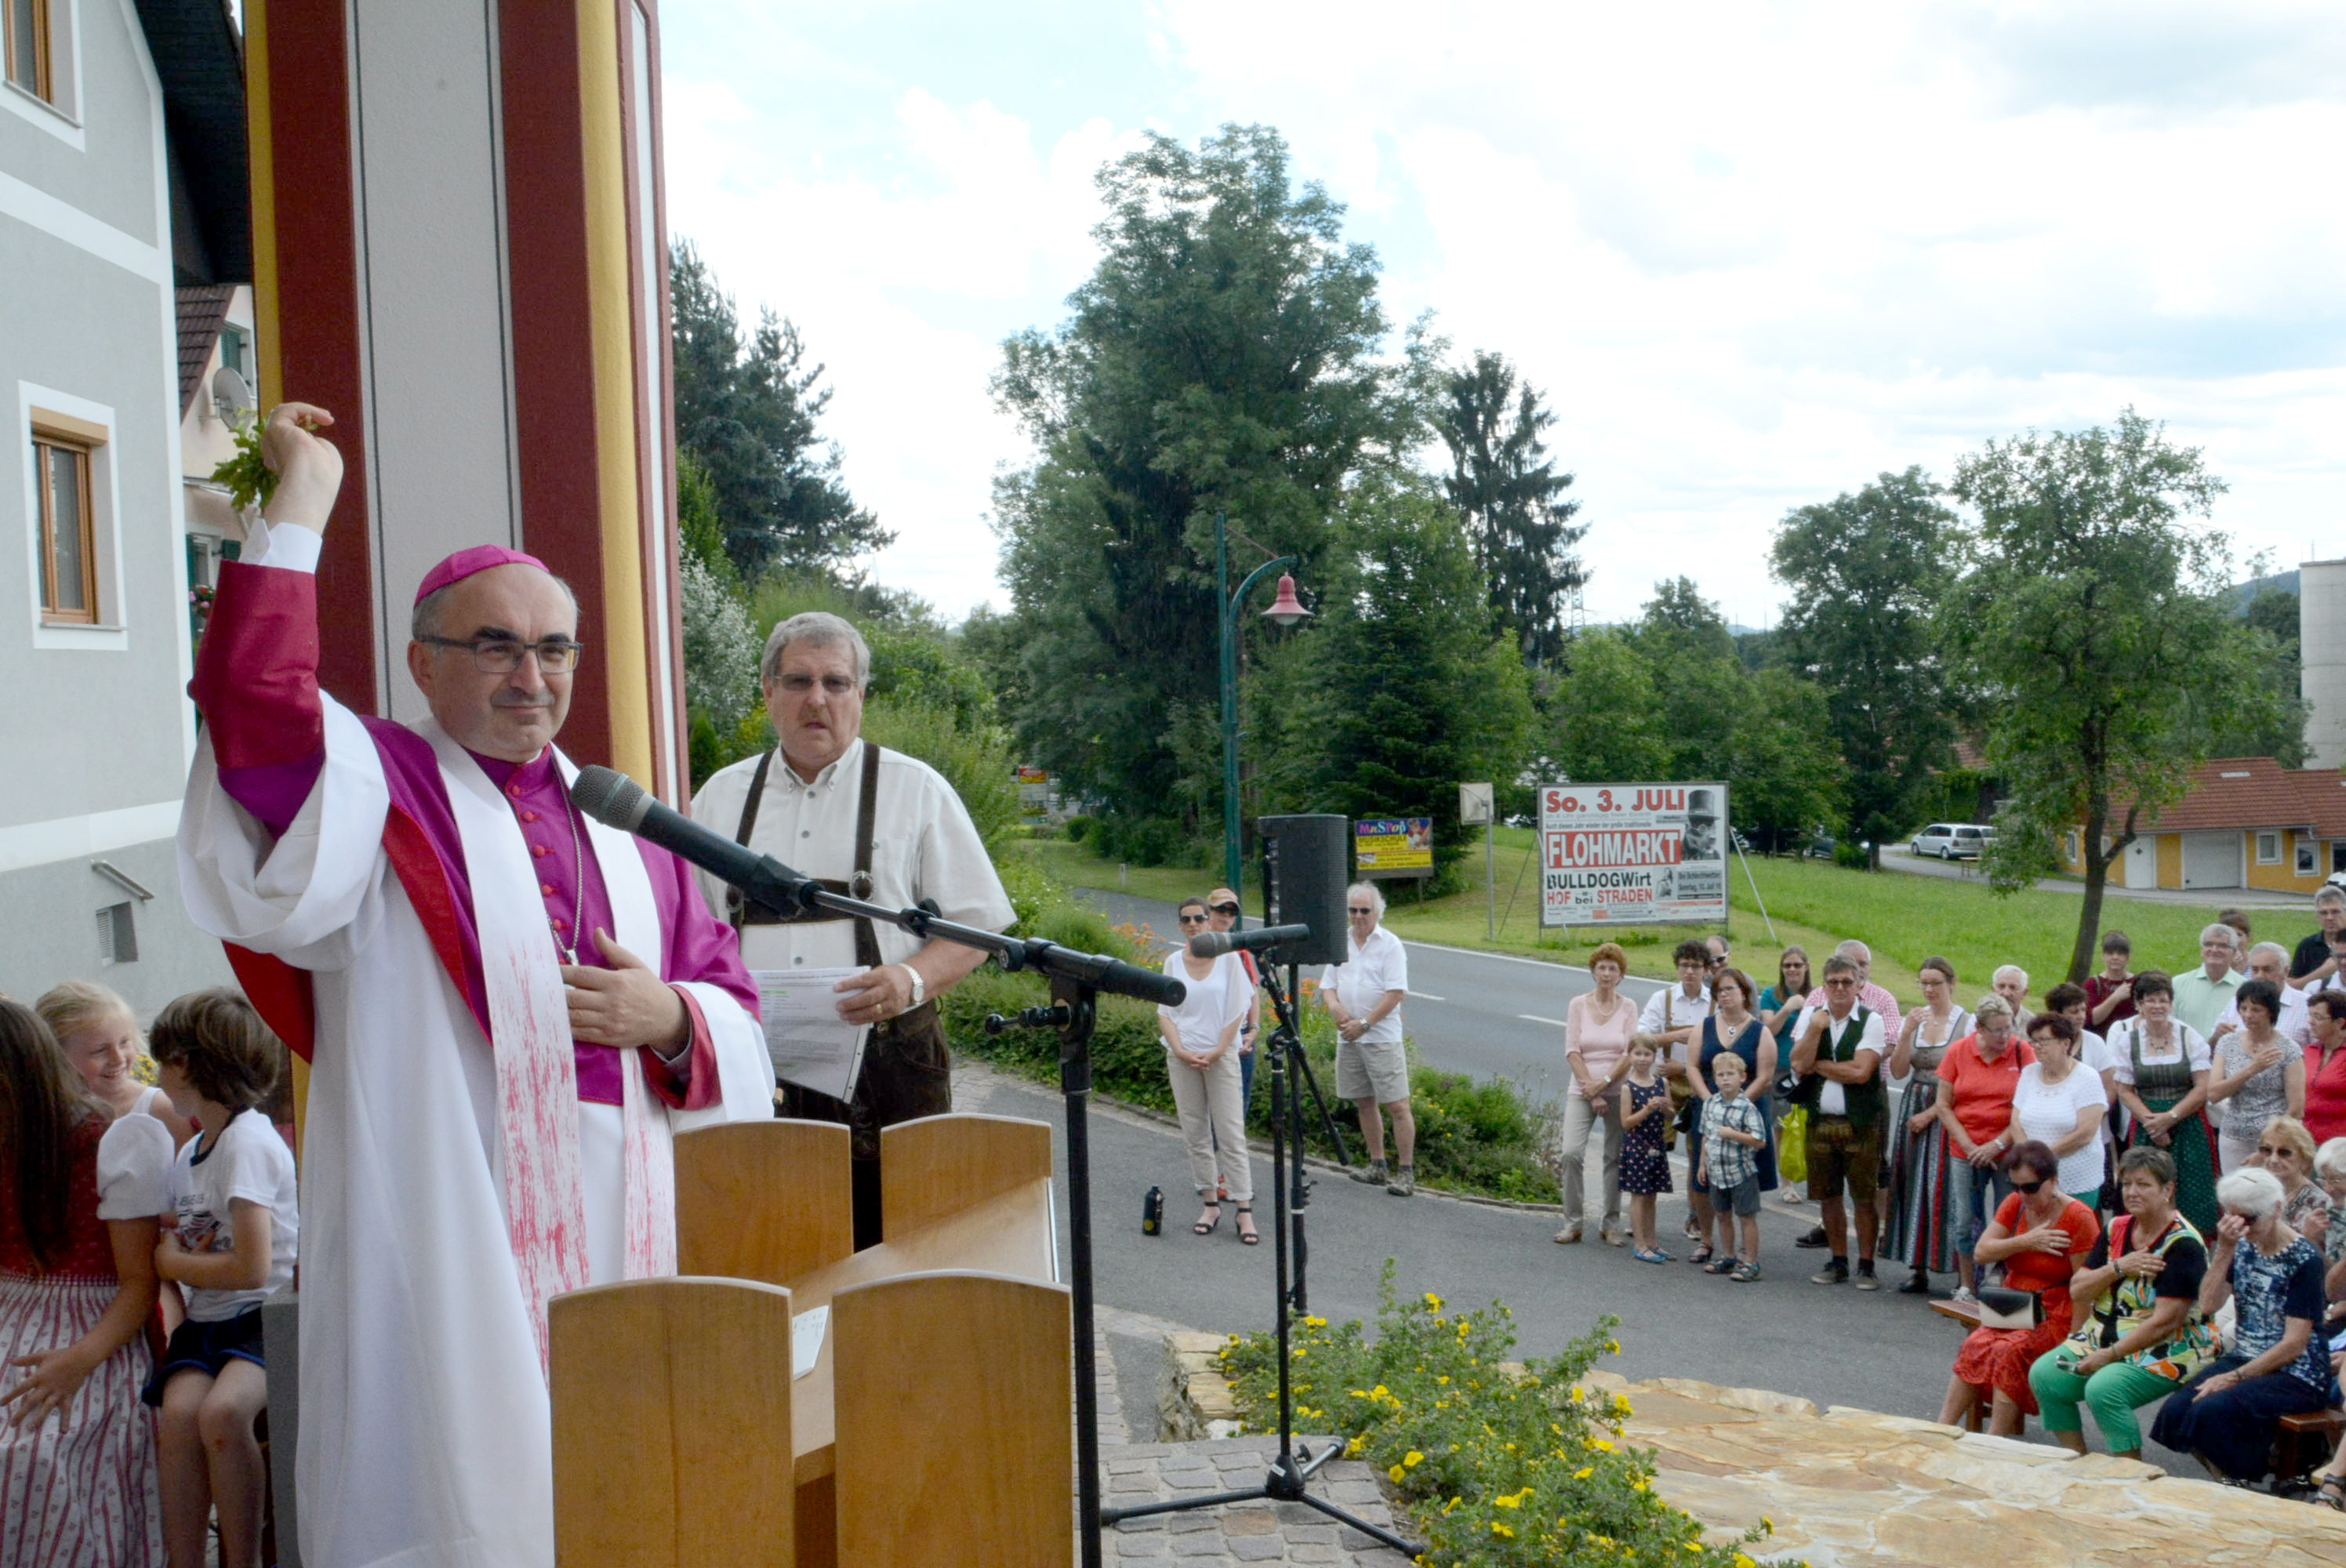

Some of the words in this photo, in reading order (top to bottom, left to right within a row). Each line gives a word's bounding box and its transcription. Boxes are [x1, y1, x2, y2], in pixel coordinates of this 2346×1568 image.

[1546, 790, 1587, 813] So.
[1597, 789, 1622, 812] 3.
[1632, 789, 1684, 811] JULI
[1549, 831, 1680, 866] FLOHMARKT
[1547, 872, 1651, 890] BULLDOGWirt
[1547, 891, 1571, 906] HOF
[1575, 896, 1593, 905] bei
[1597, 888, 1653, 904] STRADEN
